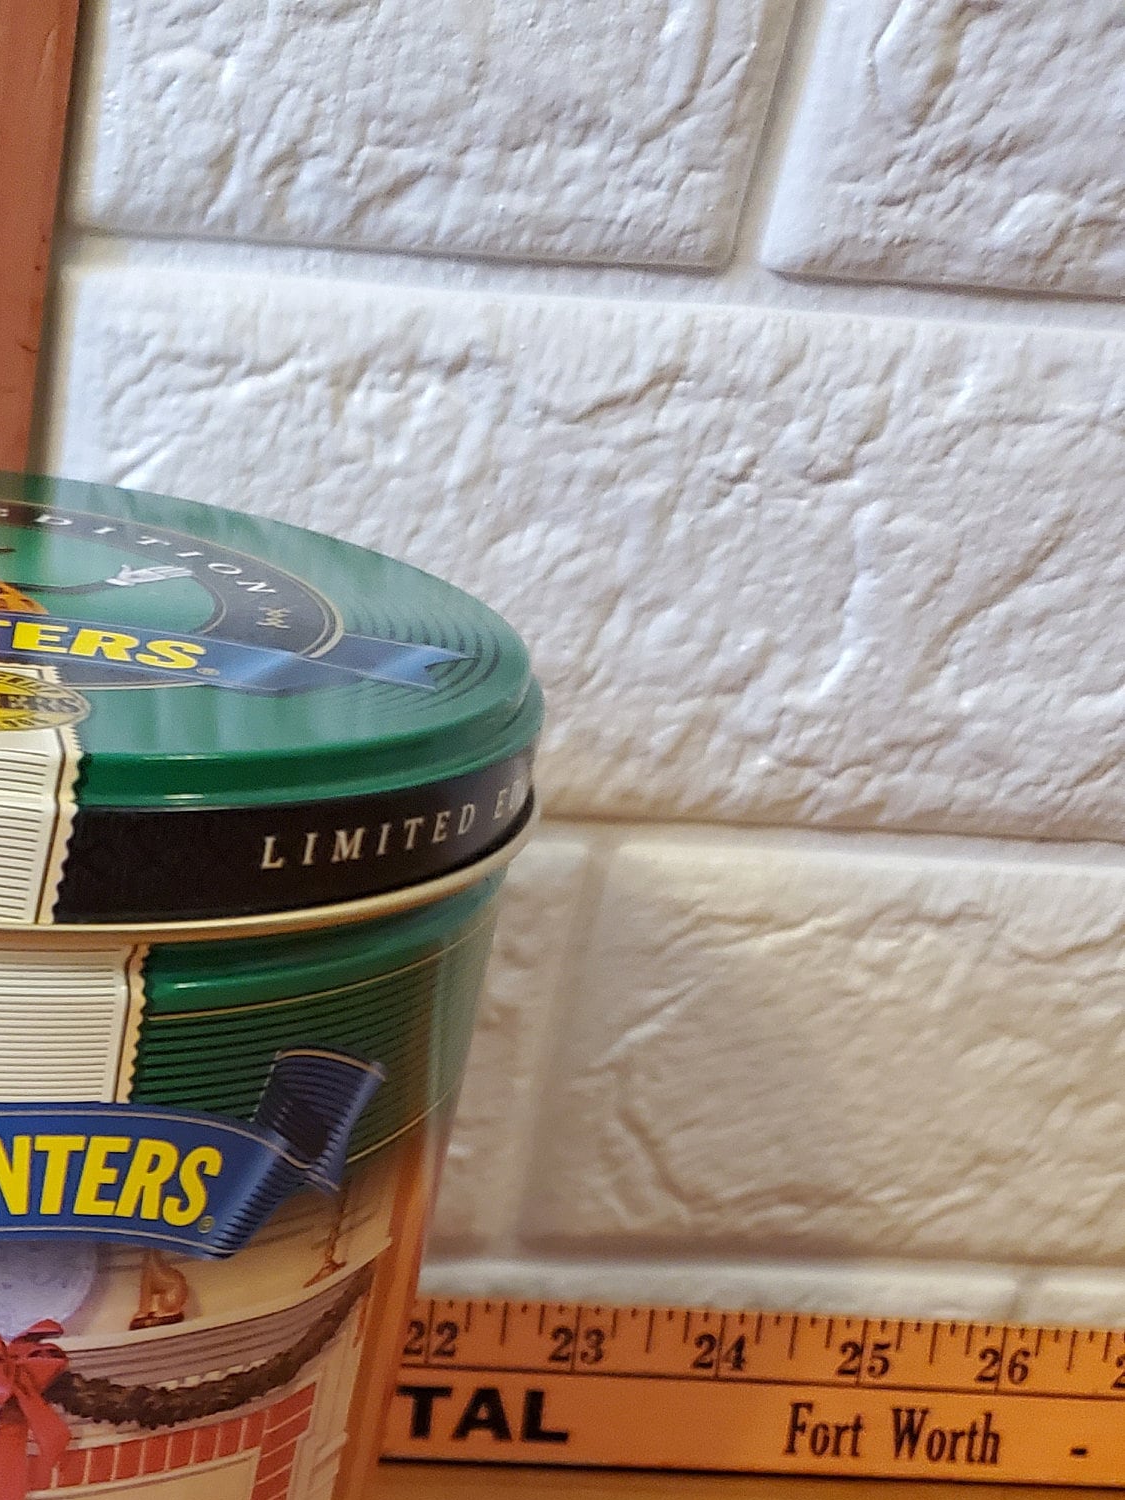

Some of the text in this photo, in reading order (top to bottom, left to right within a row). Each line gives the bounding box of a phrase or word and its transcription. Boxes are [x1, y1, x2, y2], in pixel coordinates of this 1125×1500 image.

[261, 802, 475, 870] LIMITED
[402, 1319, 459, 1358] 22
[548, 1325, 605, 1364] 23
[691, 1332, 746, 1371] 24
[836, 1340, 892, 1378] 25
[974, 1347, 1031, 1385] 26
[396, 1385, 569, 1444] TAL
[784, 1402, 1001, 1466] Fort Worth
